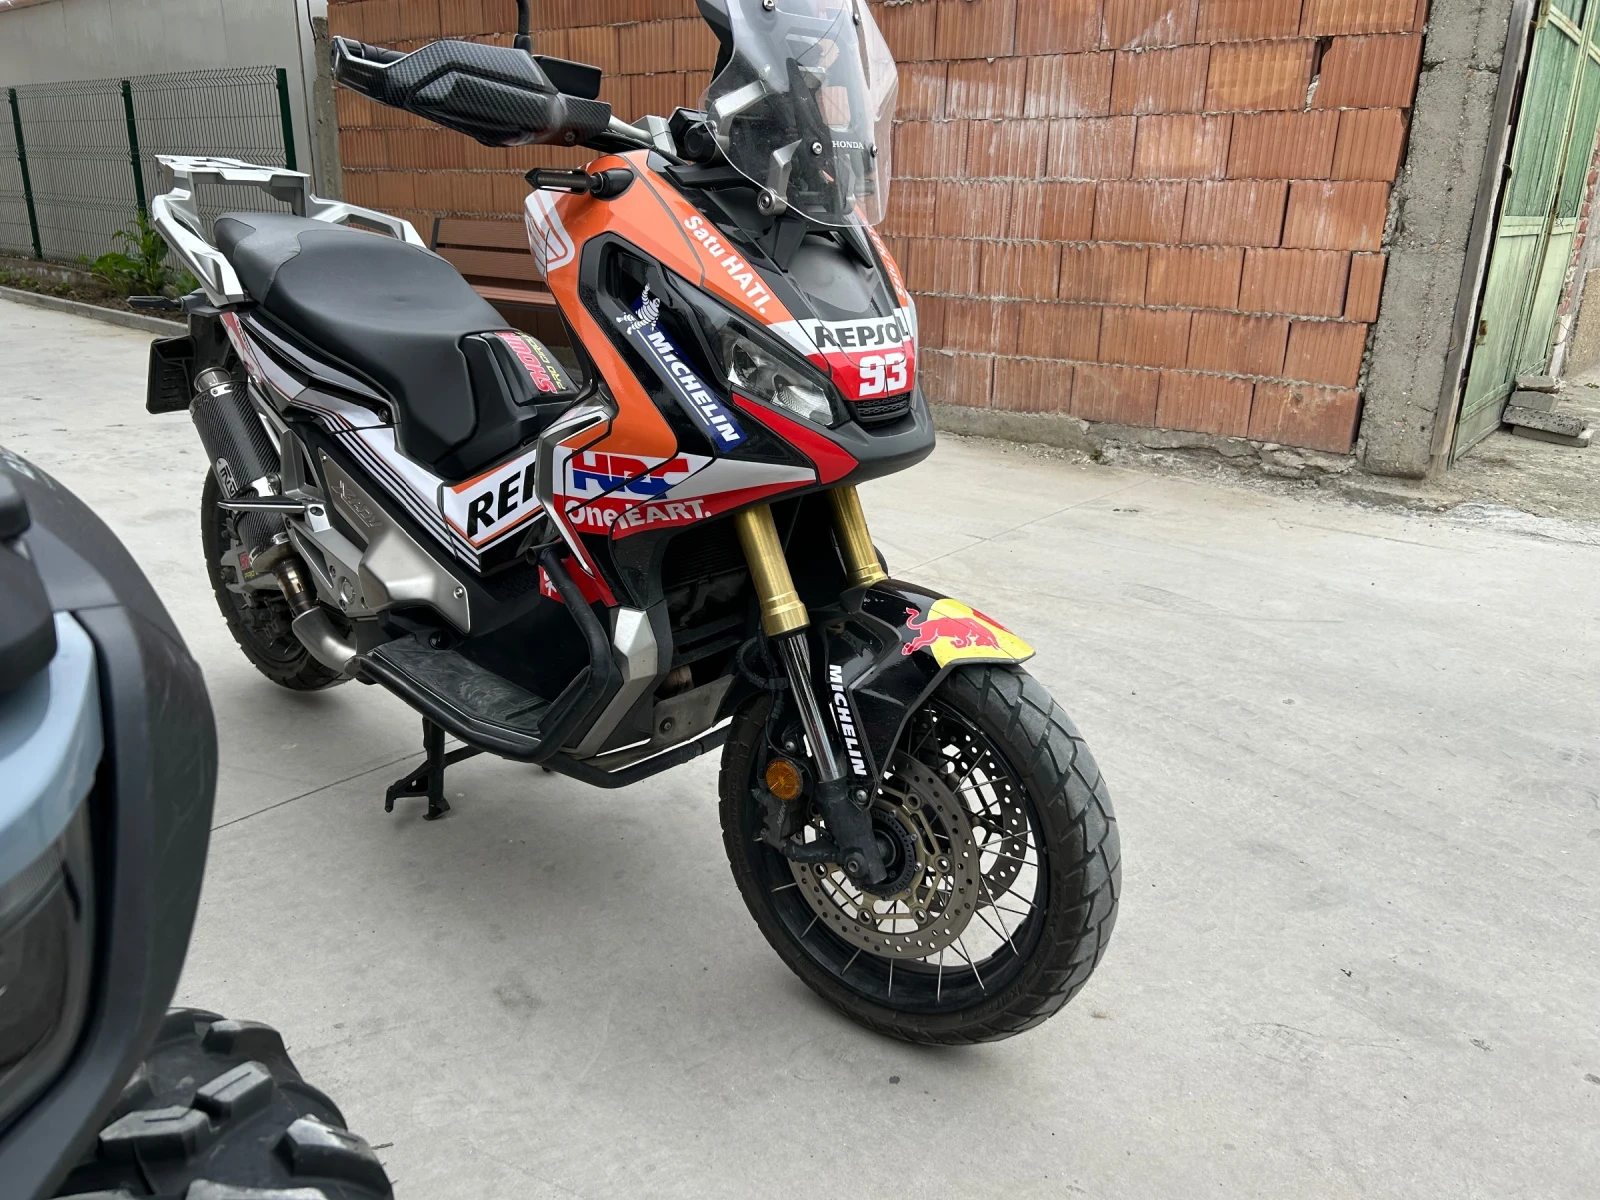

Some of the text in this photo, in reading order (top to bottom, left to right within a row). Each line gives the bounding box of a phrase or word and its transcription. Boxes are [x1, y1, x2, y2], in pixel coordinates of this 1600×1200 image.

[831, 140, 865, 150] HONDA
[684, 215, 767, 314] Satu HATI.
[814, 315, 910, 348] REPSOL
[648, 330, 741, 443] MICHELIN
[859, 352, 908, 396] 93
[571, 449, 690, 500] HRC
[565, 500, 618, 527] One
[829, 664, 868, 776] MICHELIN
